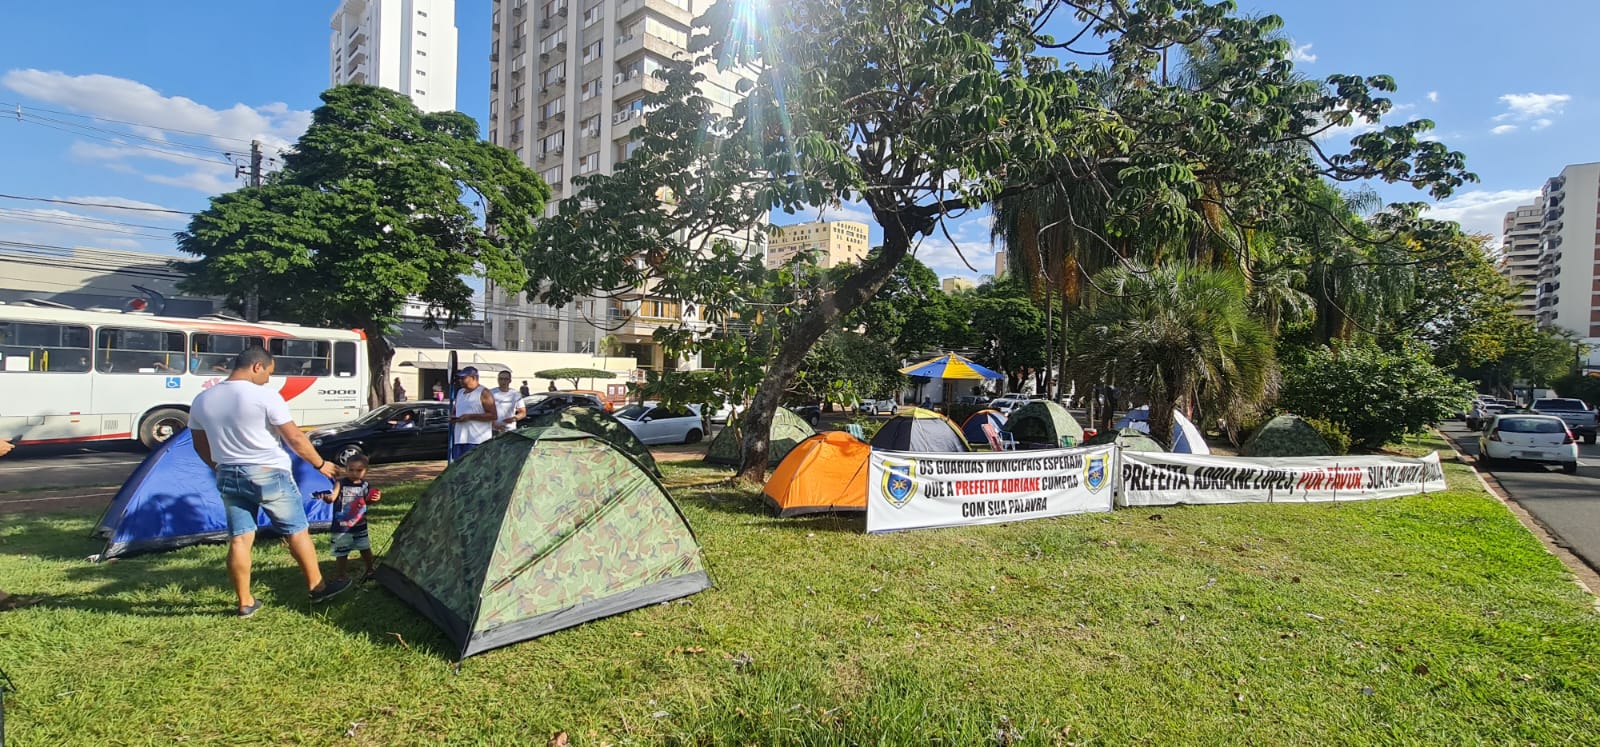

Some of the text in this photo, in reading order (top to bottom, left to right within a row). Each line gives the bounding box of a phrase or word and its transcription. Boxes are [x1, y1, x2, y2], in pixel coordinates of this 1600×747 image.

[920, 455, 1083, 475] OS GUARDAS MUNICIPAIS ESPERAM
[924, 475, 1079, 498] QUE A PREFEITA ADRIANE CUMPRA
[1122, 464, 1190, 491] PREFEITA
[1193, 466, 1257, 490] ADRIANE
[1296, 468, 1325, 490] POR
[1367, 466, 1386, 489] SUA
[962, 497, 1048, 518] COM SUA PALAVRA
